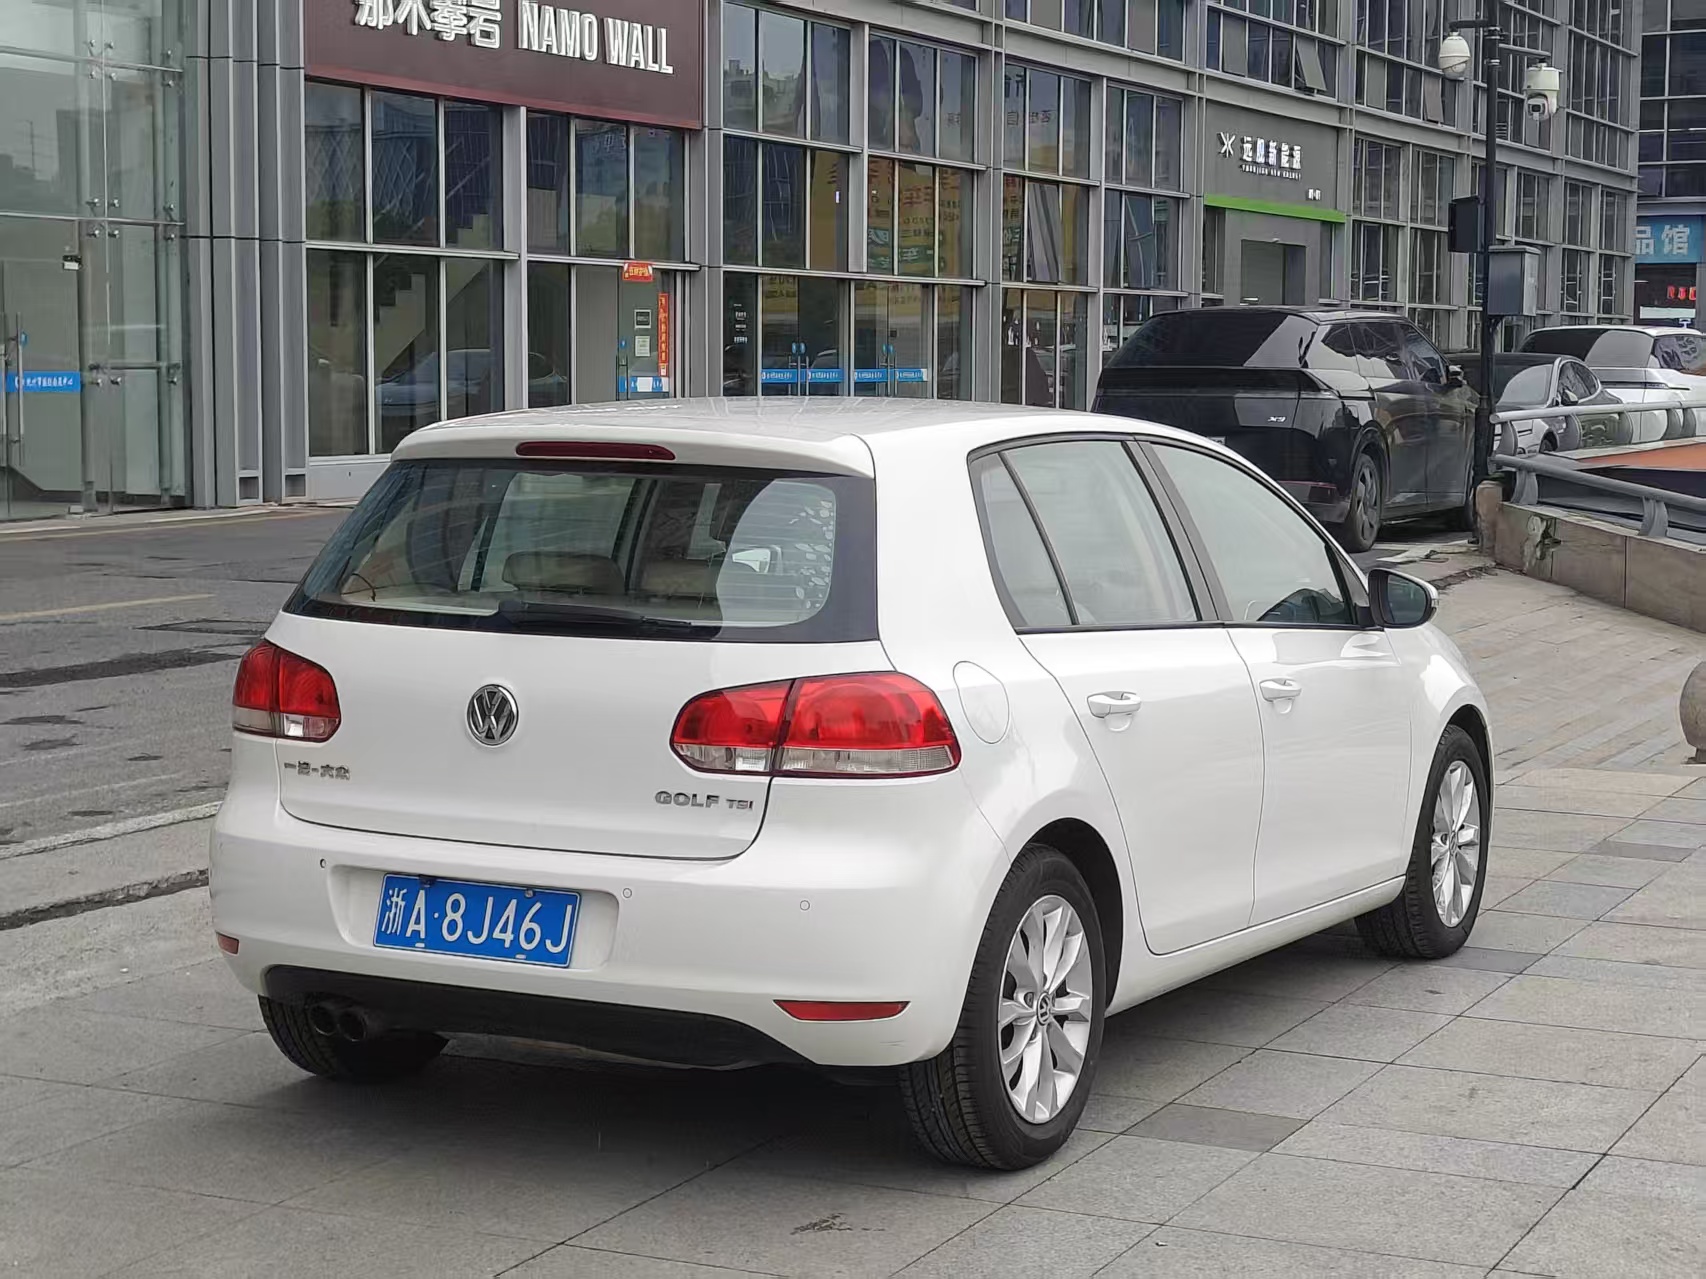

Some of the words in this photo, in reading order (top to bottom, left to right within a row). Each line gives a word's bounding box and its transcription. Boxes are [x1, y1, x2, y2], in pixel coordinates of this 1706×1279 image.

[517, 0, 599, 61] NAMO
[603, 17, 674, 74] WALL
[655, 790, 719, 808] GOLF
[726, 798, 754, 810] TSI
